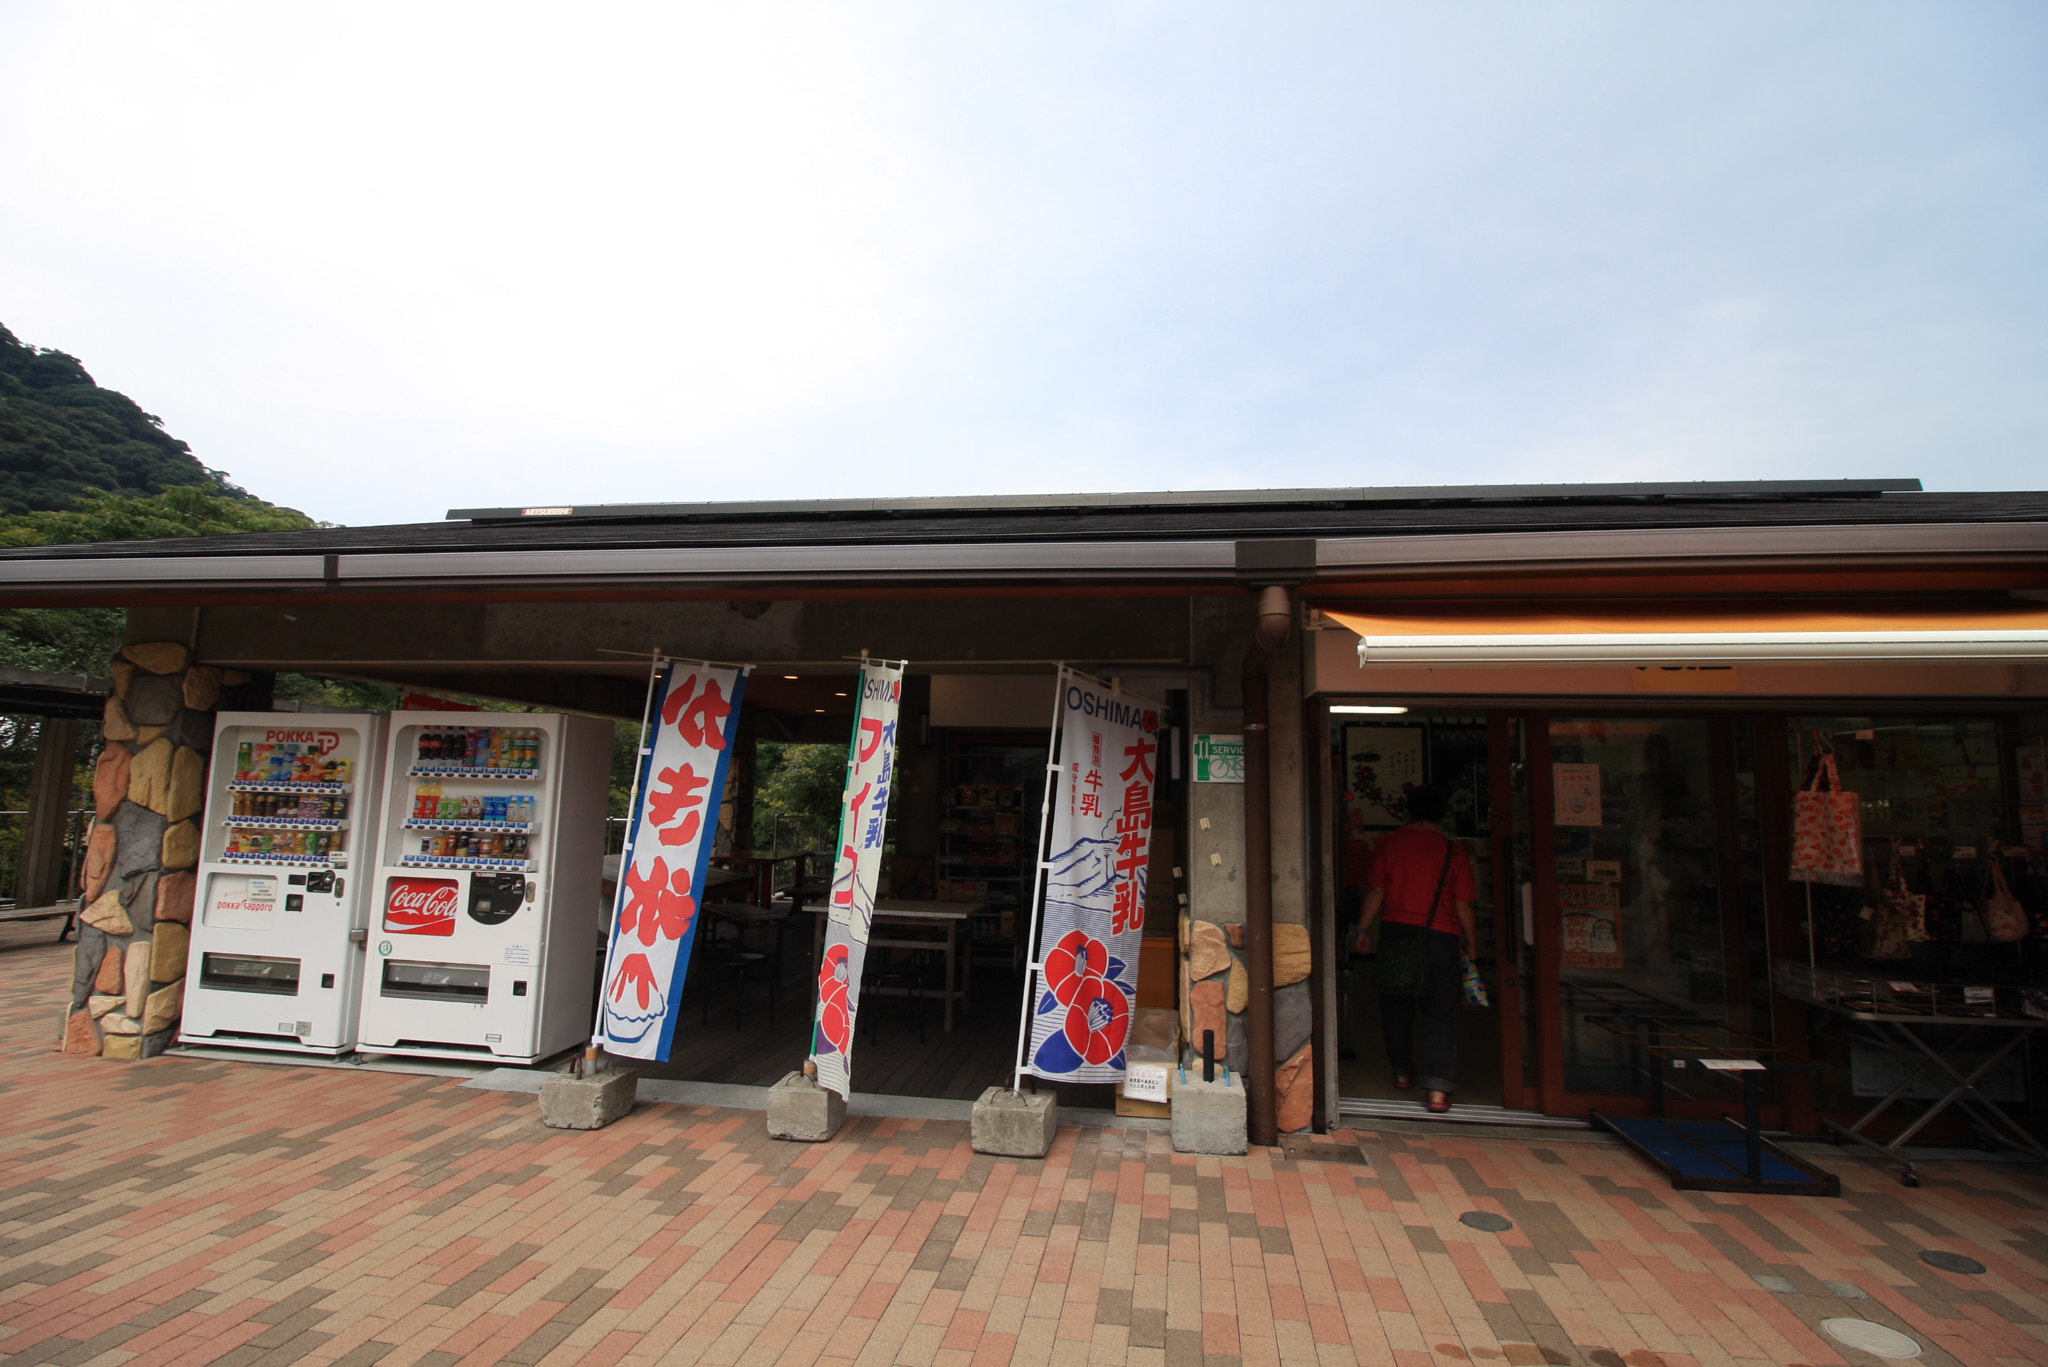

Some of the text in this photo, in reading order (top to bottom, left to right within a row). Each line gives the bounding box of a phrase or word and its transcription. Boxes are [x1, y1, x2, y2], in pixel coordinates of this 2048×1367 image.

[1067, 686, 1142, 731] OSHIMA
[266, 730, 315, 743] POKKA
[1080, 769, 1103, 819] 牛乳
[1111, 737, 1157, 936] 大島牛乳
